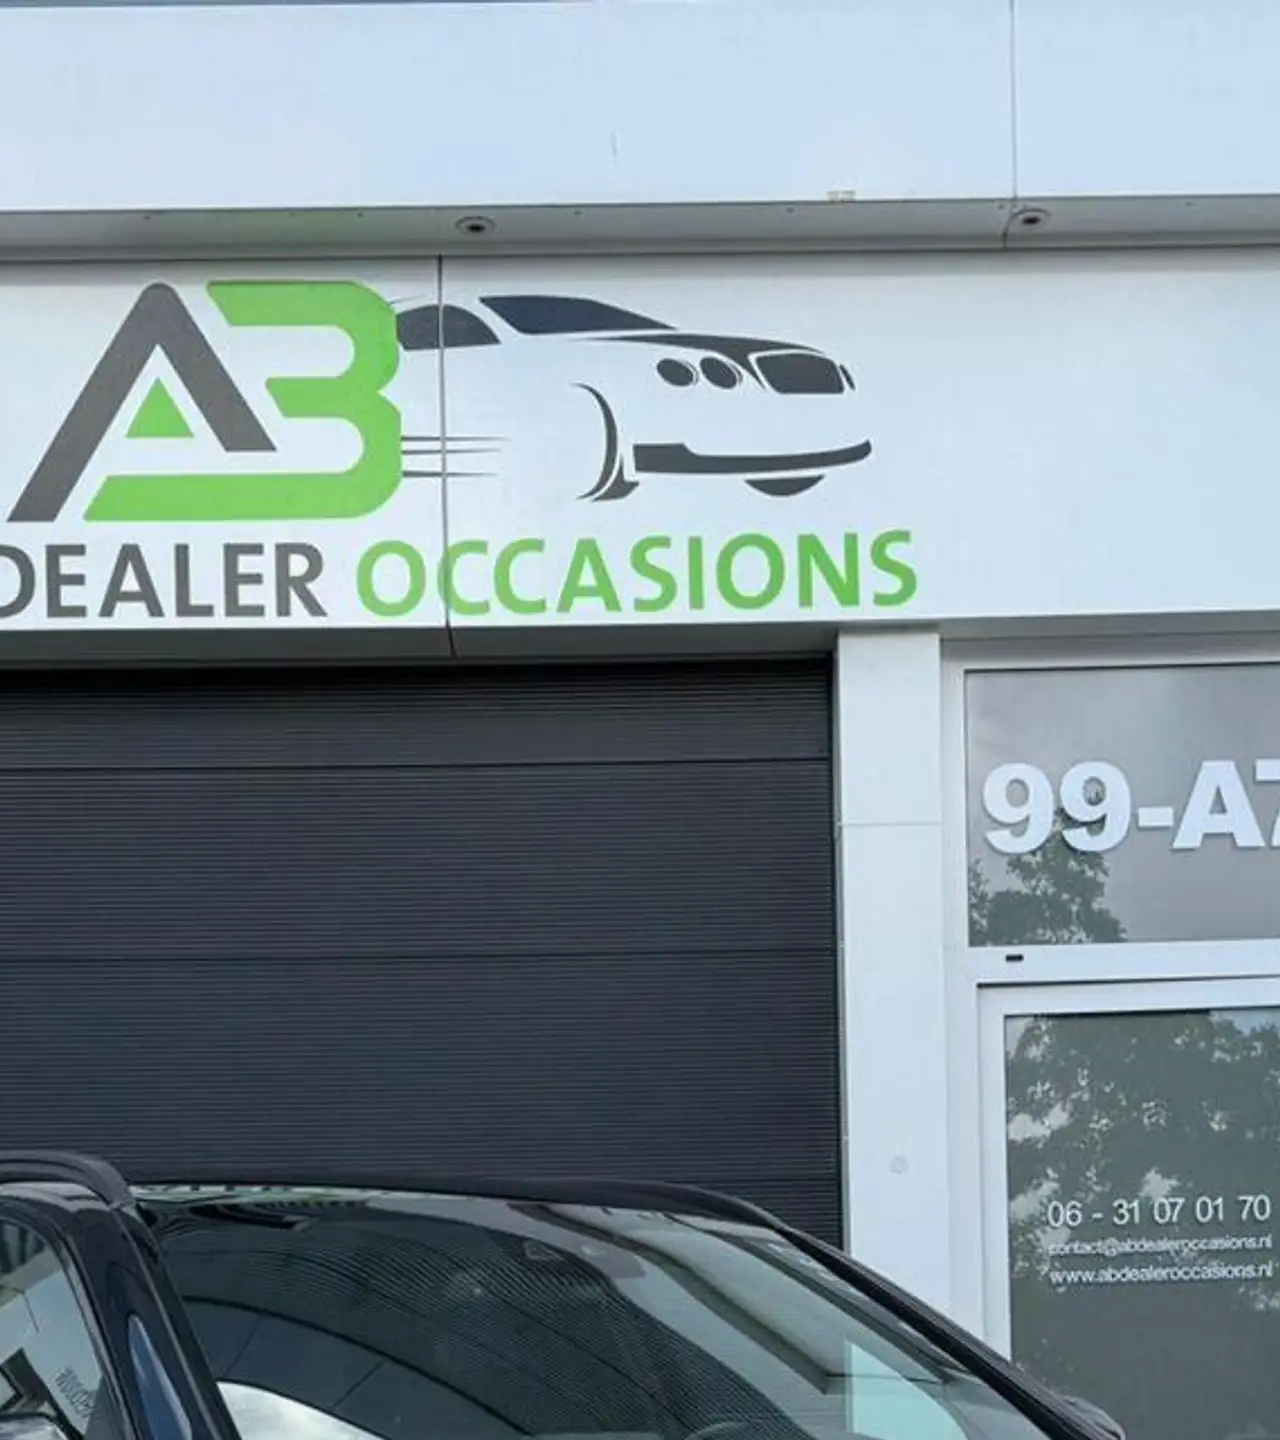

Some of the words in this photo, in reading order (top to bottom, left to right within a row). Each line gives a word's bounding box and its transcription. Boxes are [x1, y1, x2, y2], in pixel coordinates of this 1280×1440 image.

[8, 280, 403, 522] AB
[355, 529, 919, 617] OCCASIONS
[1048, 1200, 1083, 1227] 06
[1113, 1198, 1141, 1226] 31
[1153, 1197, 1186, 1225] 07
[1195, 1196, 1224, 1223] 01
[1237, 1194, 1272, 1221] 70
[1048, 1259, 1273, 1285] www.abdealeroccasions.nl
